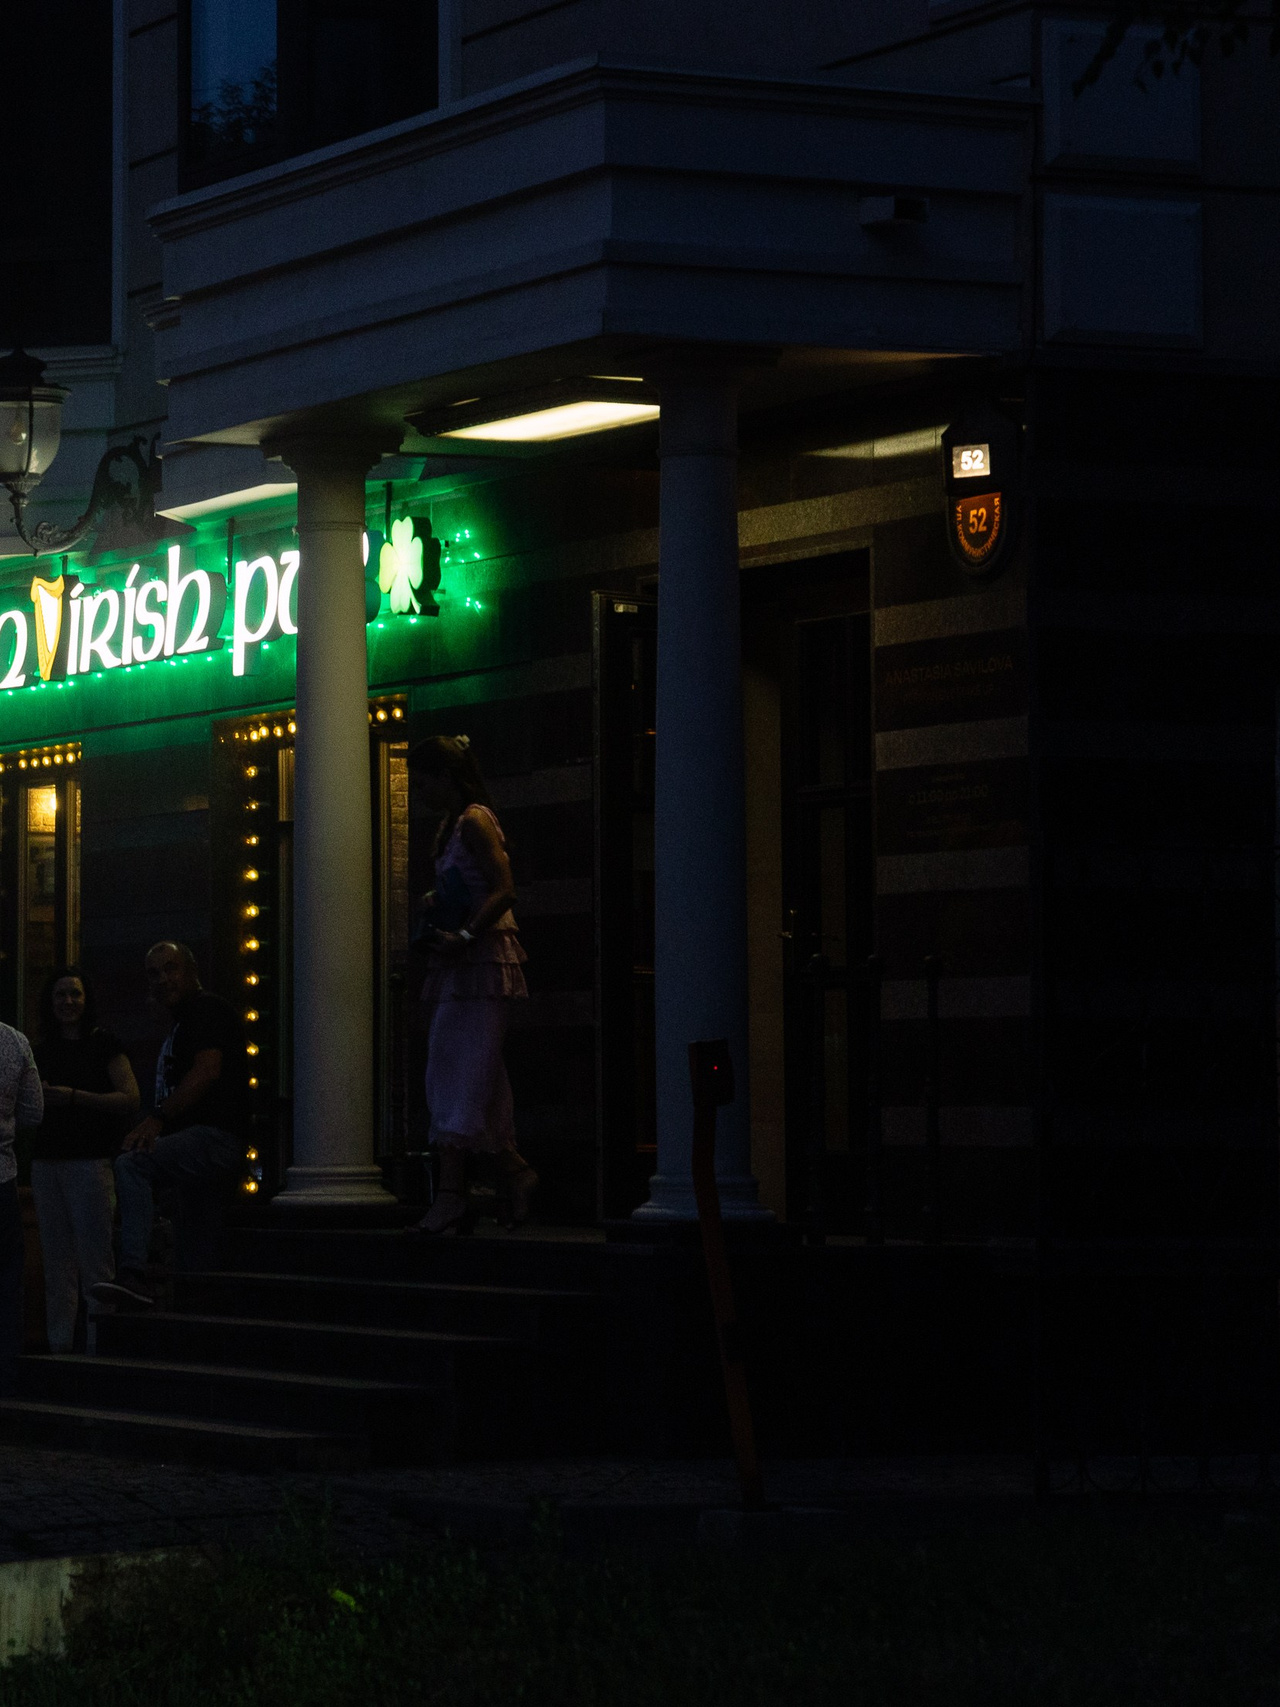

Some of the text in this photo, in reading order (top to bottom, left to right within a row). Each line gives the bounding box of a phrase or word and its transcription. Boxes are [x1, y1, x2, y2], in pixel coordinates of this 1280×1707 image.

[960, 449, 985, 471] 52
[969, 507, 987, 534] 52
[884, 655, 1015, 687] ANASTASIA SAVILOVA
